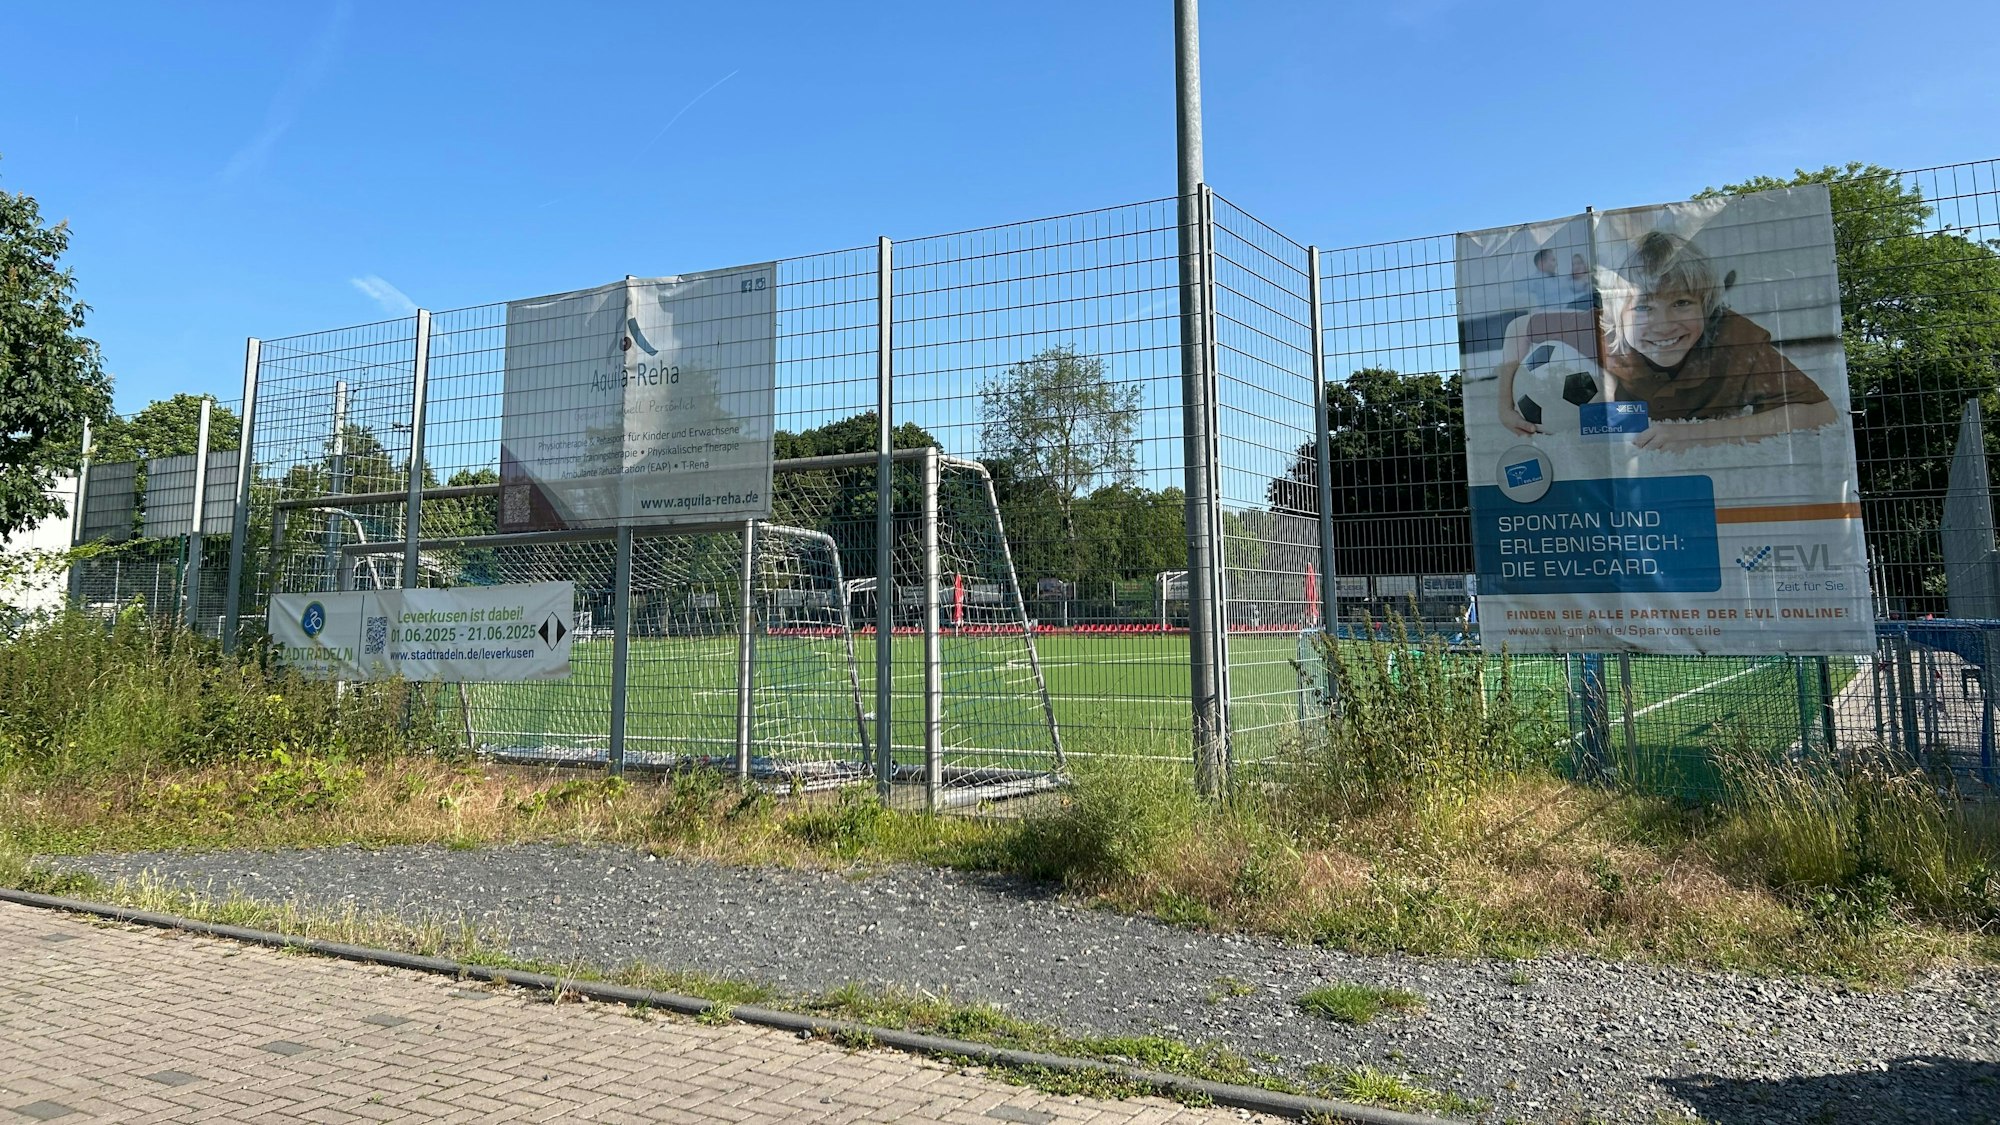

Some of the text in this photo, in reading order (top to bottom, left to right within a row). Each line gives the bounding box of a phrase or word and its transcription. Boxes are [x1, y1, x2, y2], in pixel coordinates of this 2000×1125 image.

[591, 360, 679, 397] Aquila-Reha
[649, 396, 696, 413] Persönlich
[1626, 404, 1646, 413] EVL
[538, 440, 588, 452] Physiotherapie
[628, 432, 641, 442] für
[642, 429, 670, 441] Kinder
[671, 427, 687, 439] und
[689, 425, 740, 438] Erwachsene
[1582, 425, 1623, 434] EVL-Card
[647, 444, 703, 458] Physikalische
[704, 442, 740, 454] Therapie
[561, 469, 598, 480] Ambulante
[647, 461, 672, 473] (EAP)
[681, 460, 710, 470] T-Rena
[640, 490, 759, 511] www.aquila-reha.de
[1498, 511, 1661, 533] SPONTAN UND
[1500, 534, 1685, 555] ERLEBNISREICH:
[1773, 544, 1842, 572] EVL
[1502, 558, 1664, 578] DIE EVL-CARD.
[1777, 580, 1848, 592] Zeit für Sie.
[398, 606, 524, 624] Leverkusen ist dabei!
[1507, 607, 1849, 620] FINDEN SIE ALLE PARTNER DER EVL ONLINE!
[391, 627, 456, 643] 01.06.2025
[467, 624, 536, 641] 21.06.2025
[1507, 625, 1721, 638] www.evl-gmbhde/Sparvorteile
[273, 647, 353, 661] TADTRADELN
[390, 647, 534, 661] www.stadtradeln.de/leverkusen
